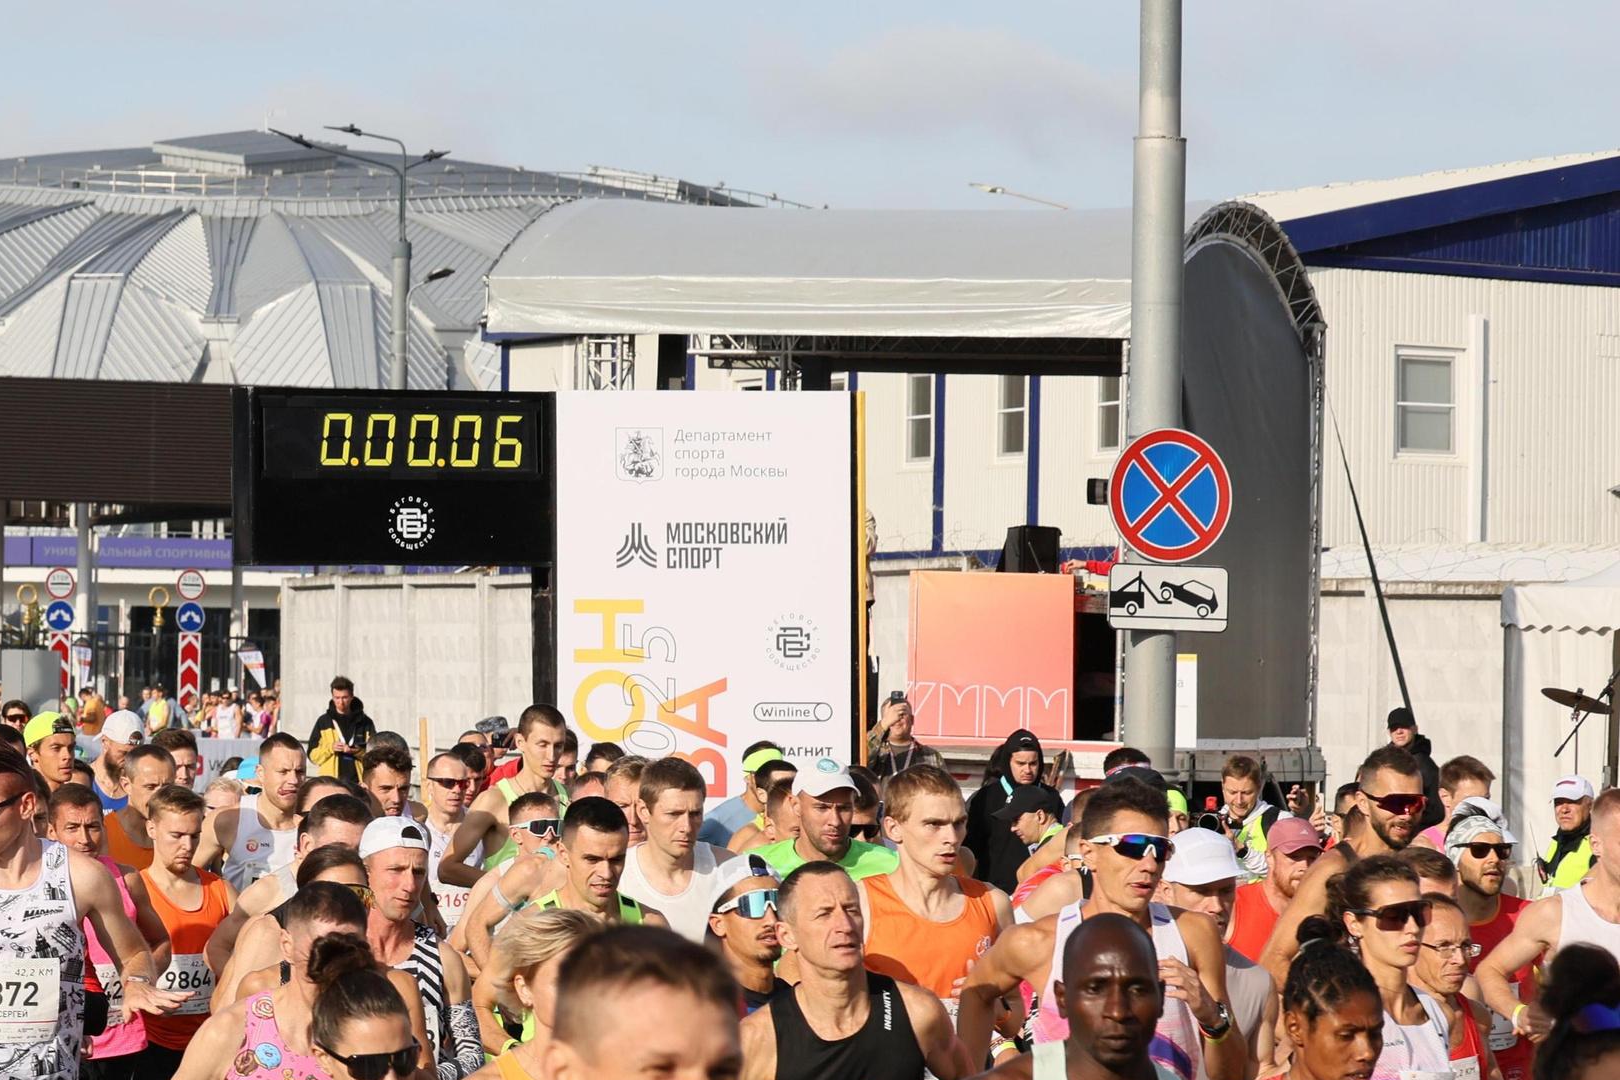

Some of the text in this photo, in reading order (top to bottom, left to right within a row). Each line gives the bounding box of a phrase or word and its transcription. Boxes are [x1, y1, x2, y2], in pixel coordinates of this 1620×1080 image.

[674, 429, 773, 443] Департамент
[674, 449, 725, 462] спорта
[675, 465, 788, 480] города Москвы
[666, 517, 788, 544] МОСКОВСКИЙ
[666, 547, 723, 569] СПОРТ
[761, 707, 810, 717] Winline
[165, 969, 212, 989] 9864
[882, 990, 892, 1031] INSANITY
